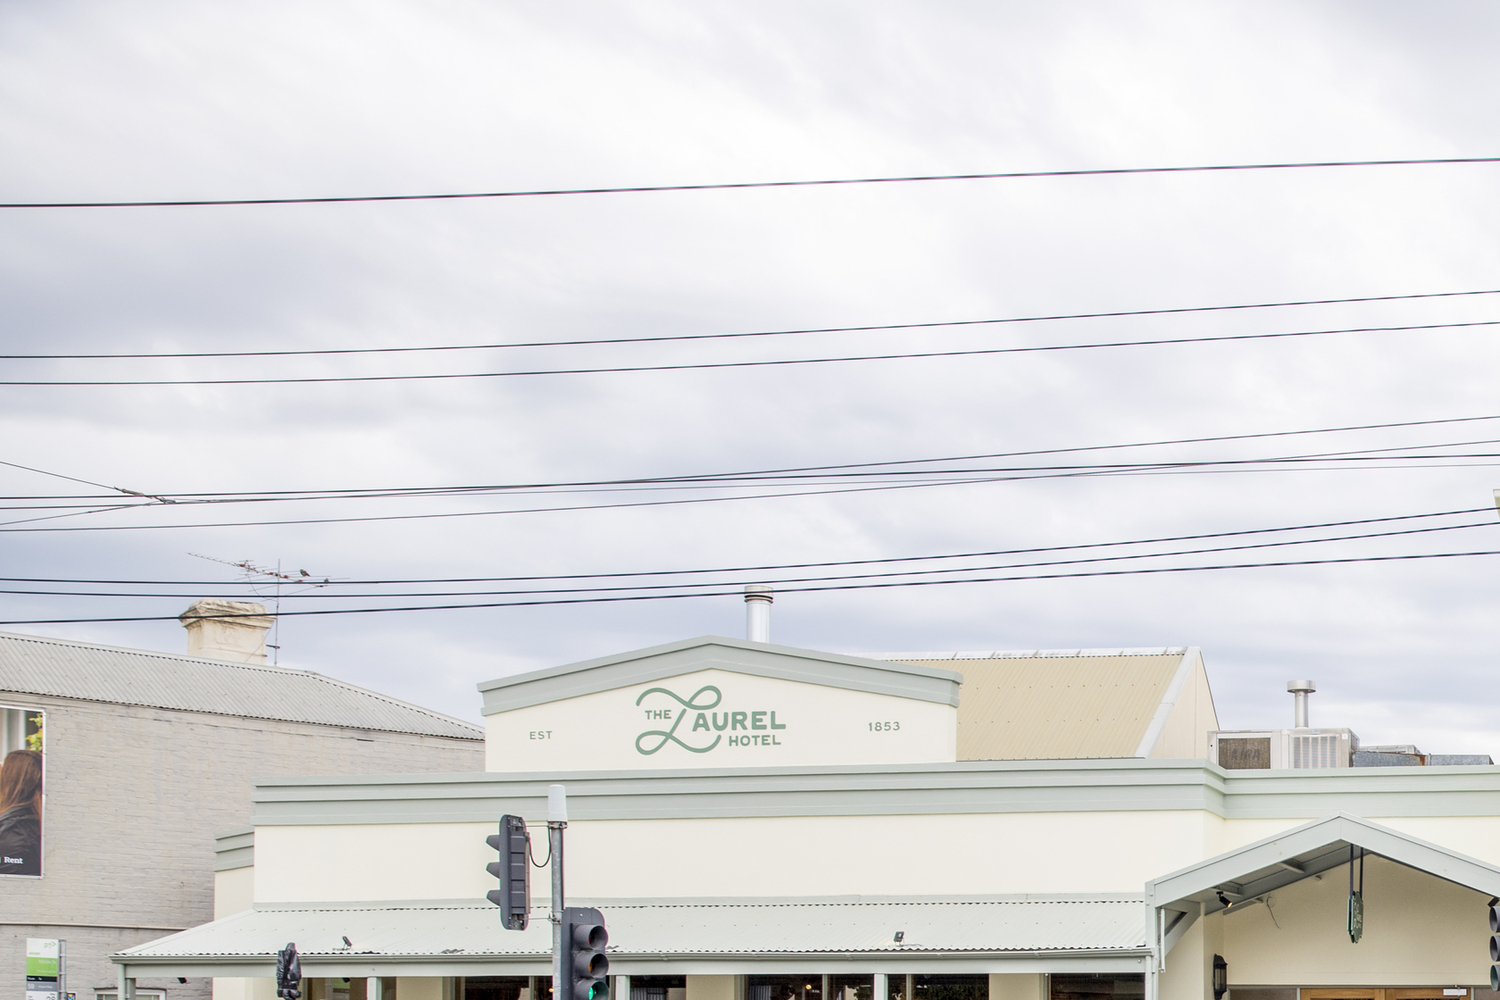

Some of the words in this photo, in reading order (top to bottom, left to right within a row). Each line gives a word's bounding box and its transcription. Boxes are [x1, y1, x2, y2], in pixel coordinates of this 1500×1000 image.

[645, 709, 672, 720] THE
[868, 721, 900, 731] 1853
[529, 730, 552, 740] EST
[728, 734, 781, 747] HOTEL
[3, 856, 24, 864] Rent
